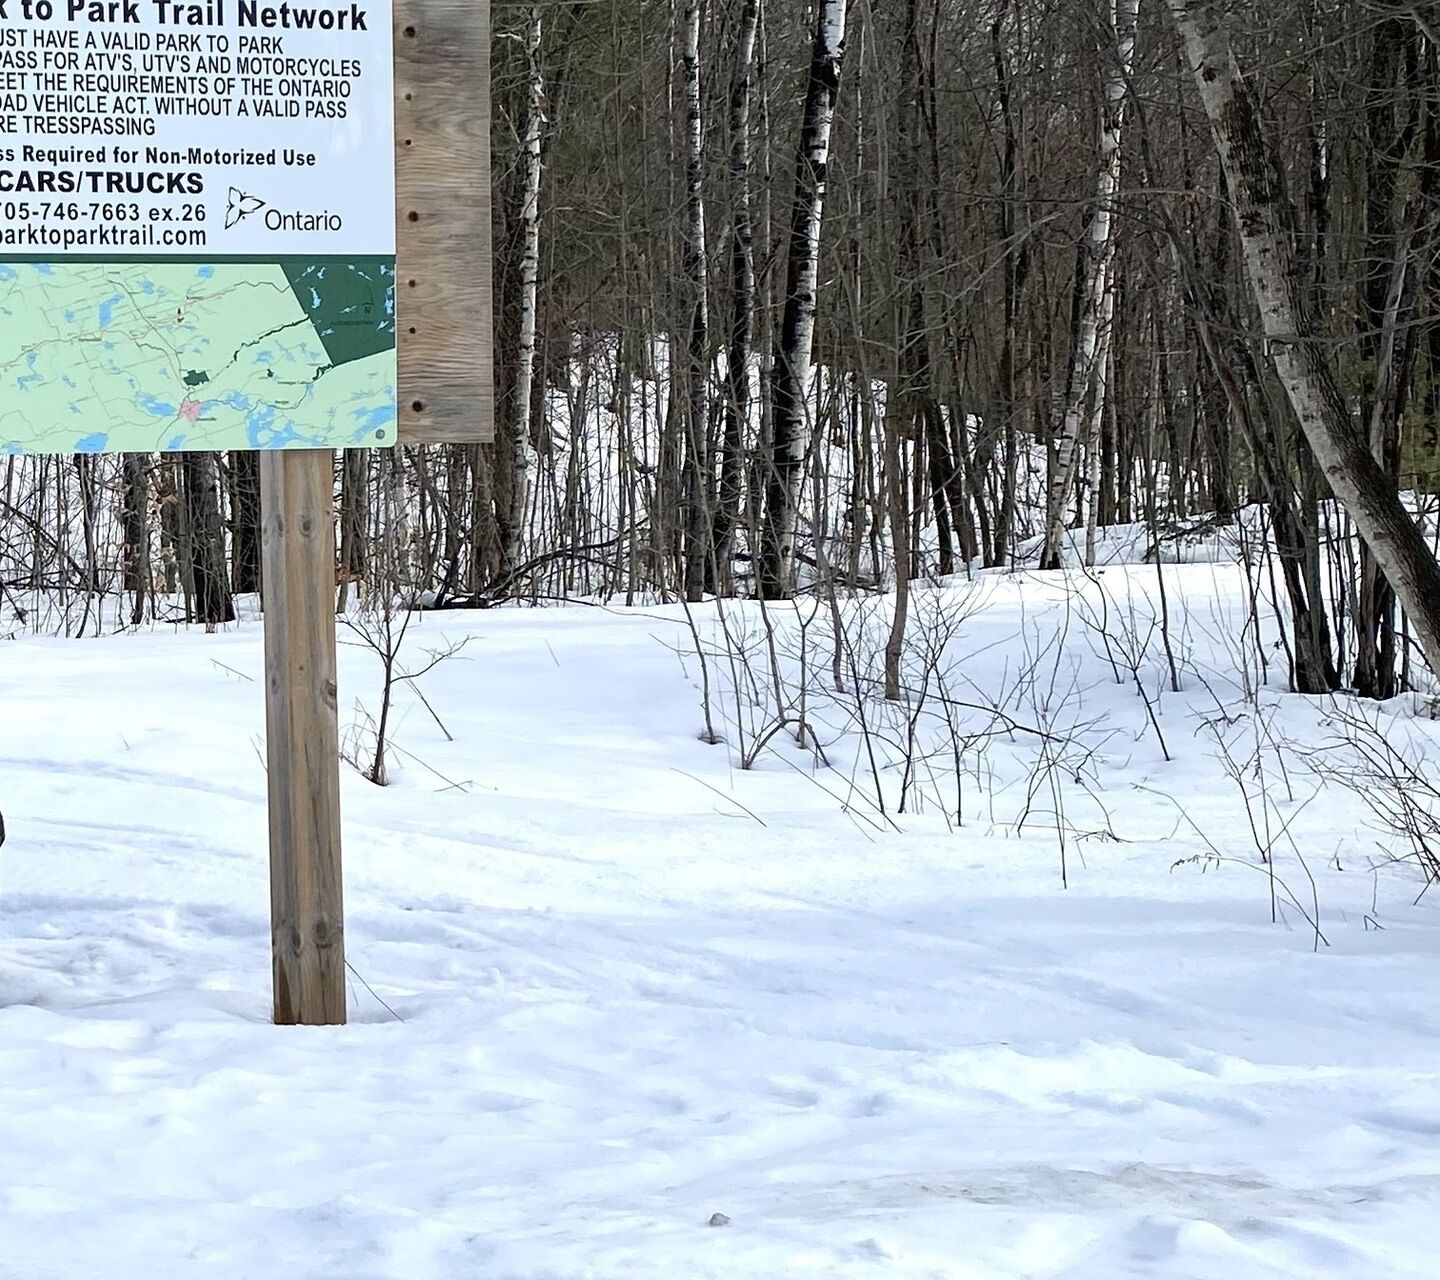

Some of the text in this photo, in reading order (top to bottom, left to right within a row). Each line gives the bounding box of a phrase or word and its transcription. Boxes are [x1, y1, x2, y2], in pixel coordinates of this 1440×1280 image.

[238, 0, 367, 30] Network
[34, 30, 79, 48] HAVE
[85, 31, 96, 49] A
[101, 32, 150, 50] VALID
[157, 33, 201, 52] PARK
[206, 35, 228, 52] TO
[239, 36, 283, 54] PARK
[44, 52, 79, 70] FOR
[85, 53, 136, 74] ATV'S,
[143, 54, 190, 72] UTV'S
[196, 56, 230, 73] AND
[237, 57, 361, 77] MOTORCYCLES
[33, 73, 67, 91] THE
[74, 74, 208, 94] REQUIREMENTS
[214, 77, 235, 95] OF
[241, 78, 273, 95] THE
[279, 79, 350, 97] ONTARIO
[33, 94, 107, 113] VEHICLE
[113, 96, 149, 114] ACT.
[155, 97, 232, 116] WITHOUT
[238, 99, 248, 116] A
[253, 99, 299, 117] VALID
[306, 101, 346, 118] PASS
[23, 116, 155, 135] TRESSPASSING
[23, 145, 105, 166] Required
[113, 147, 138, 163] for
[146, 147, 275, 165] Non-Motorized
[284, 150, 315, 166] Use
[149, 204, 205, 221] ex.26
[265, 209, 341, 230] Ontario
